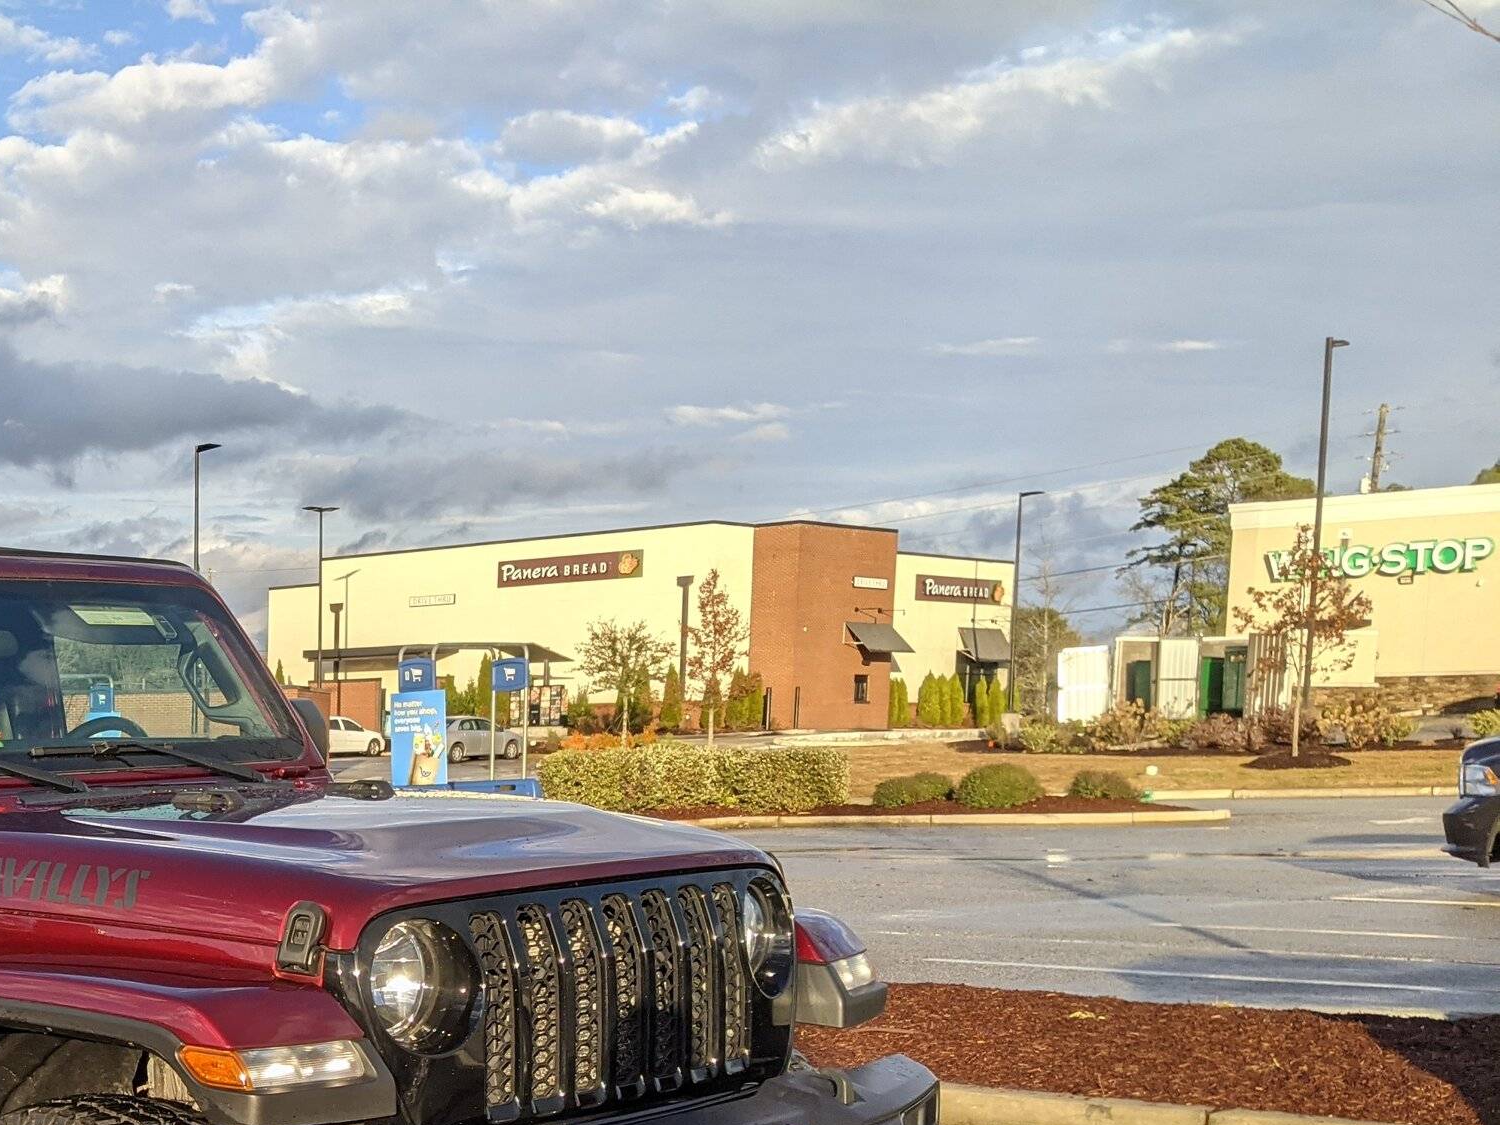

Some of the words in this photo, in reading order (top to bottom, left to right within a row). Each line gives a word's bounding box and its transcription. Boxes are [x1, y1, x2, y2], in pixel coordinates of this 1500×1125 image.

[501, 564, 559, 582] Panera
[563, 561, 608, 576] BREAD
[924, 578, 962, 597] Panera
[962, 585, 989, 599] BREAD
